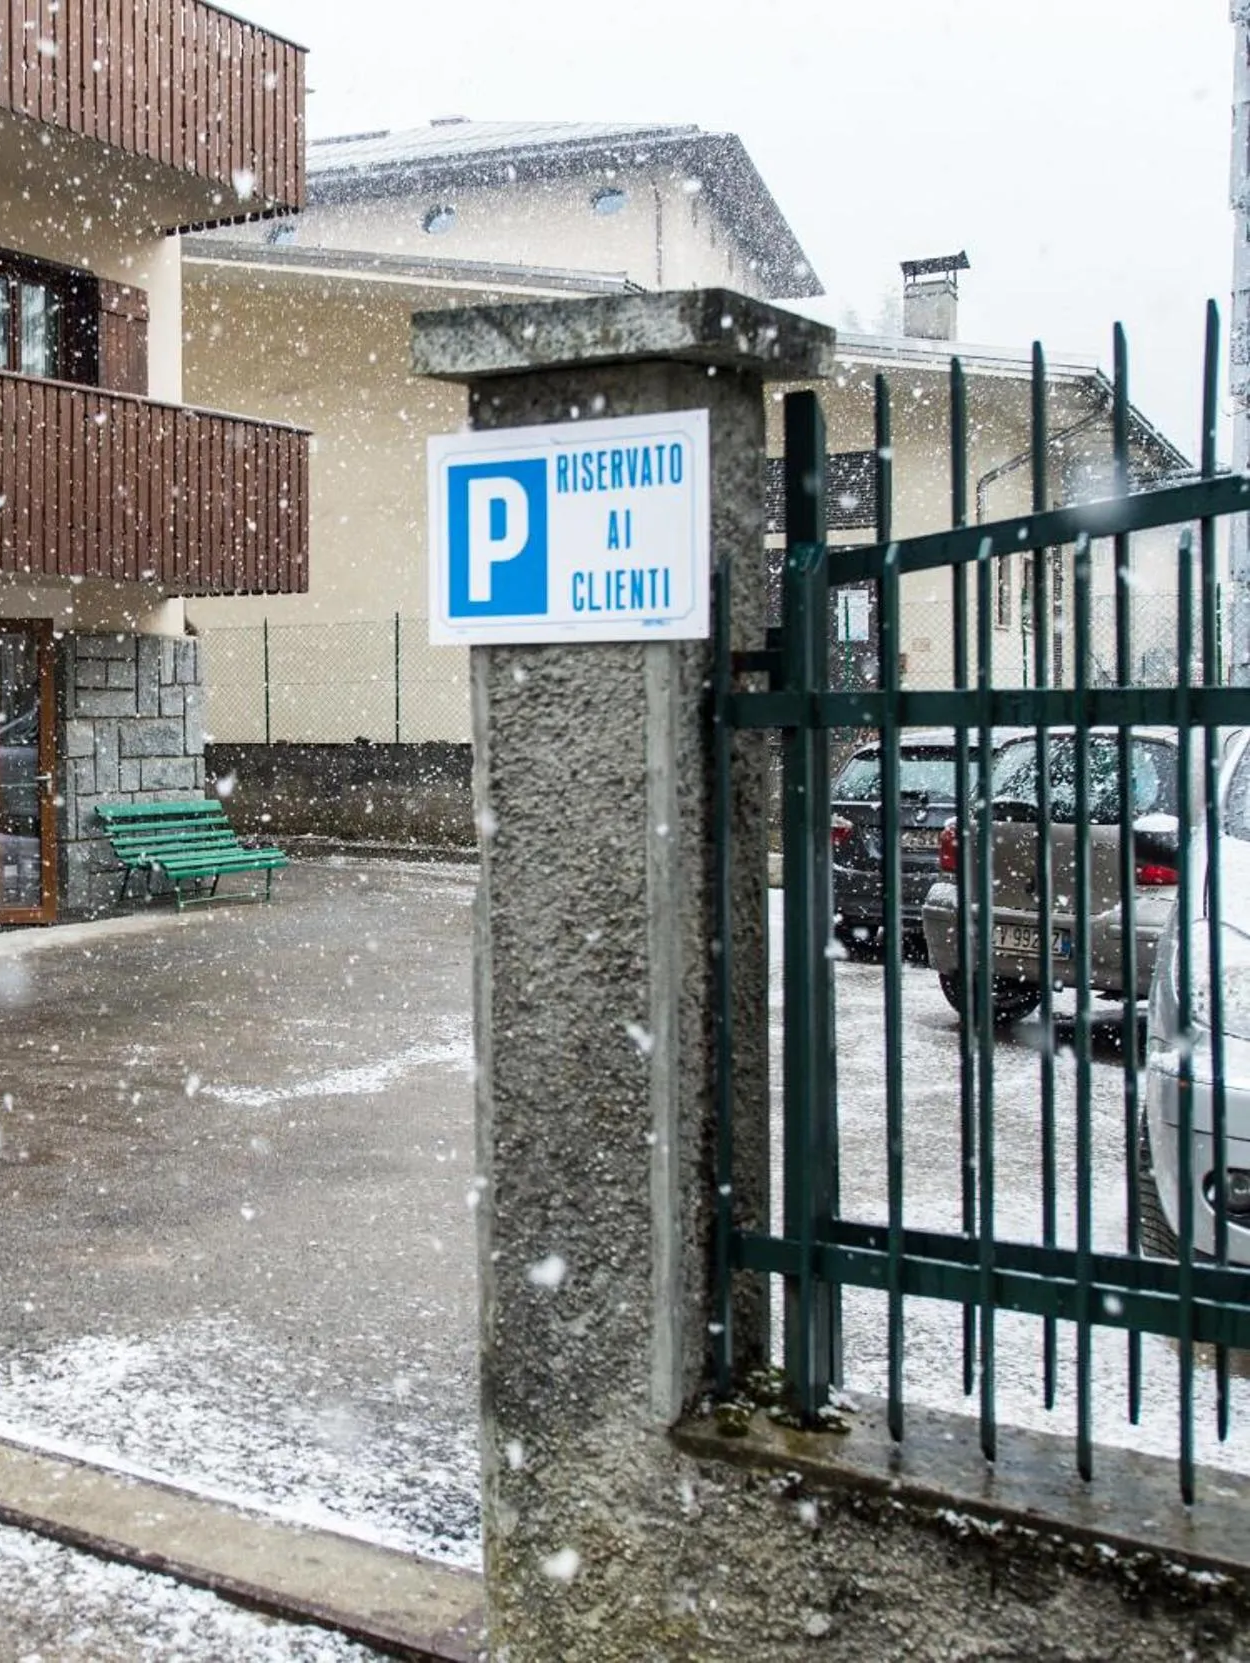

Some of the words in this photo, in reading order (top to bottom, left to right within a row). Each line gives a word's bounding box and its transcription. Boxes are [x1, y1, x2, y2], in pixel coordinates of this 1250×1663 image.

[555, 443, 683, 494] RISERVATO
[468, 476, 530, 602] P
[607, 509, 631, 550] AI
[572, 567, 670, 612] CLIENTI
